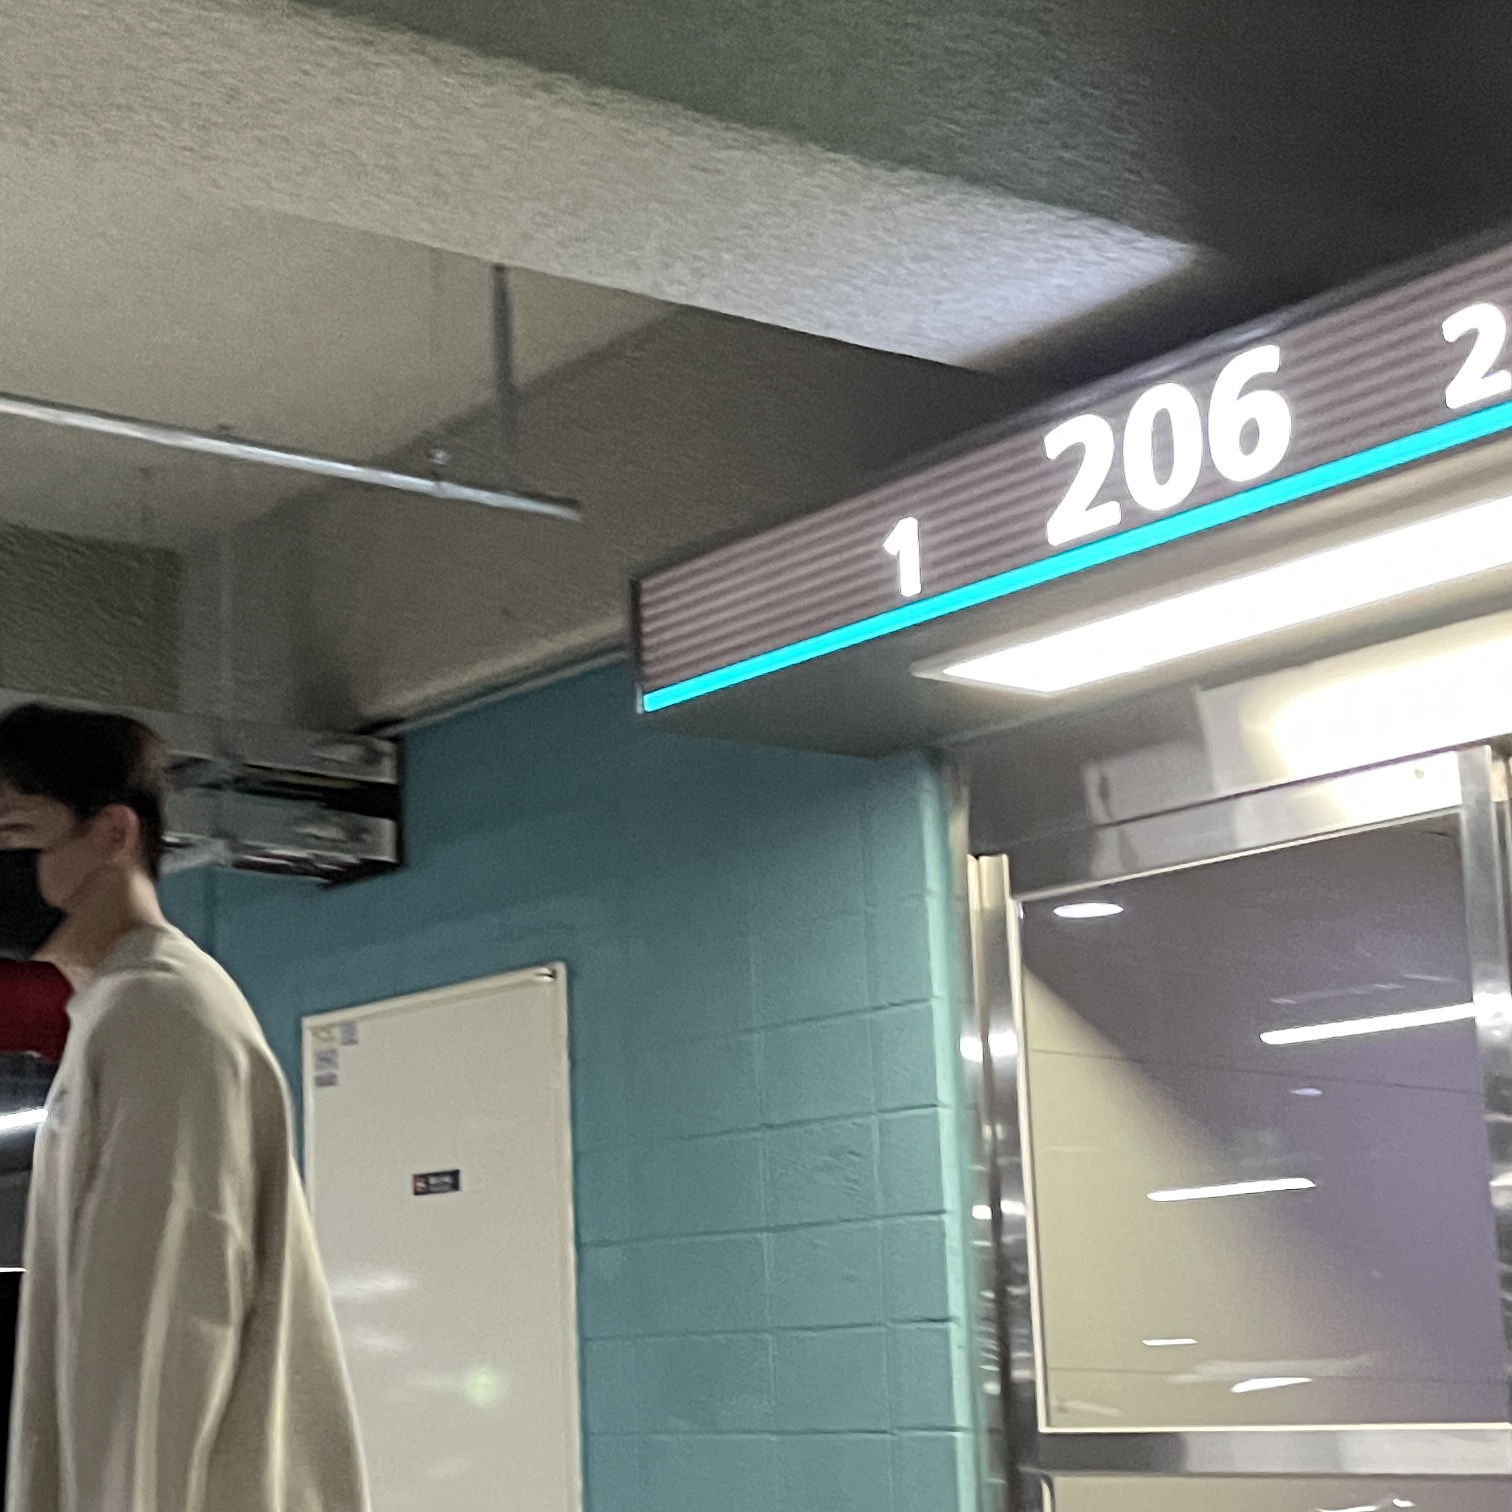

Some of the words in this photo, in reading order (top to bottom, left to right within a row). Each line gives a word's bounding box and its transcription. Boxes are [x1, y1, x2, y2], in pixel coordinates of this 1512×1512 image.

[882, 516, 922, 597] 1
[1043, 343, 1293, 547] 206
[1440, 302, 1512, 410] 2
